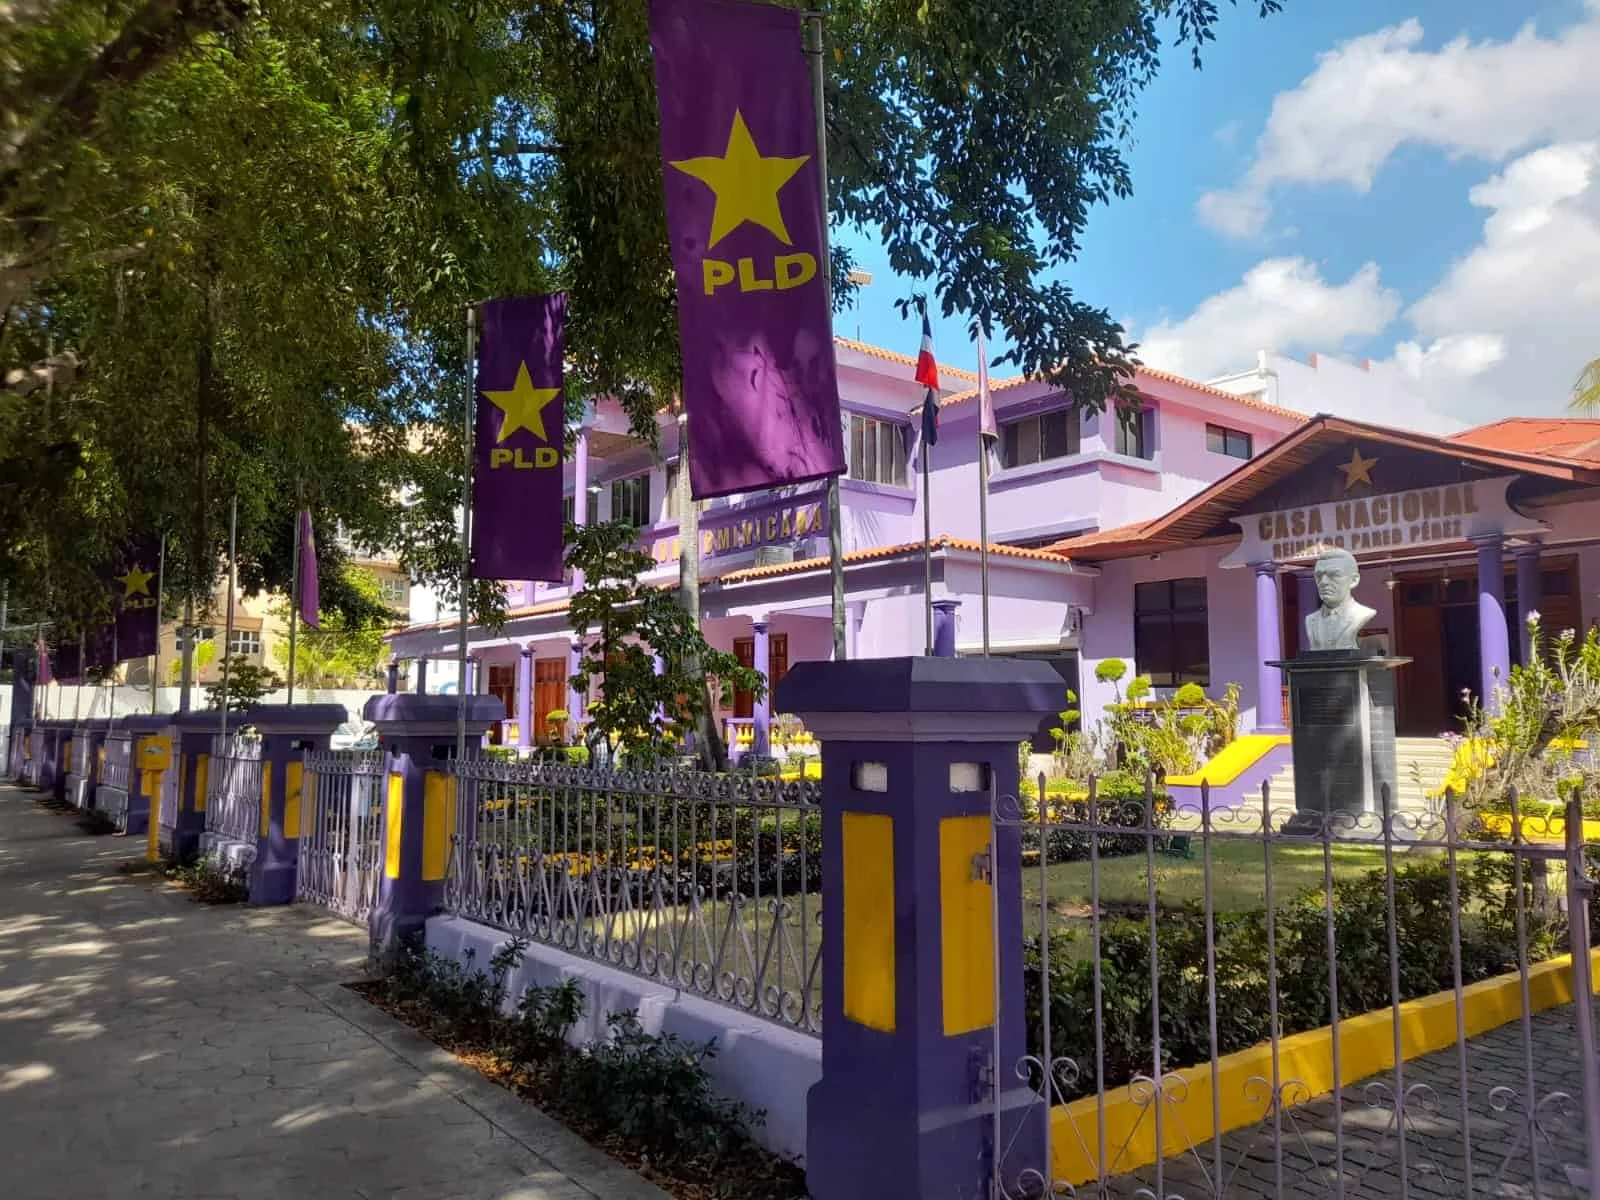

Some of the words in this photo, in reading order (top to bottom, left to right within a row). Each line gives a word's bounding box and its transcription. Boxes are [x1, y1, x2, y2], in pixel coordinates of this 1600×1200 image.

[703, 252, 817, 296] PLD
[490, 447, 559, 469] PLD
[702, 505, 824, 554] OMINICANA
[1258, 507, 1323, 541] CASA
[1335, 484, 1479, 531] NACIONAL
